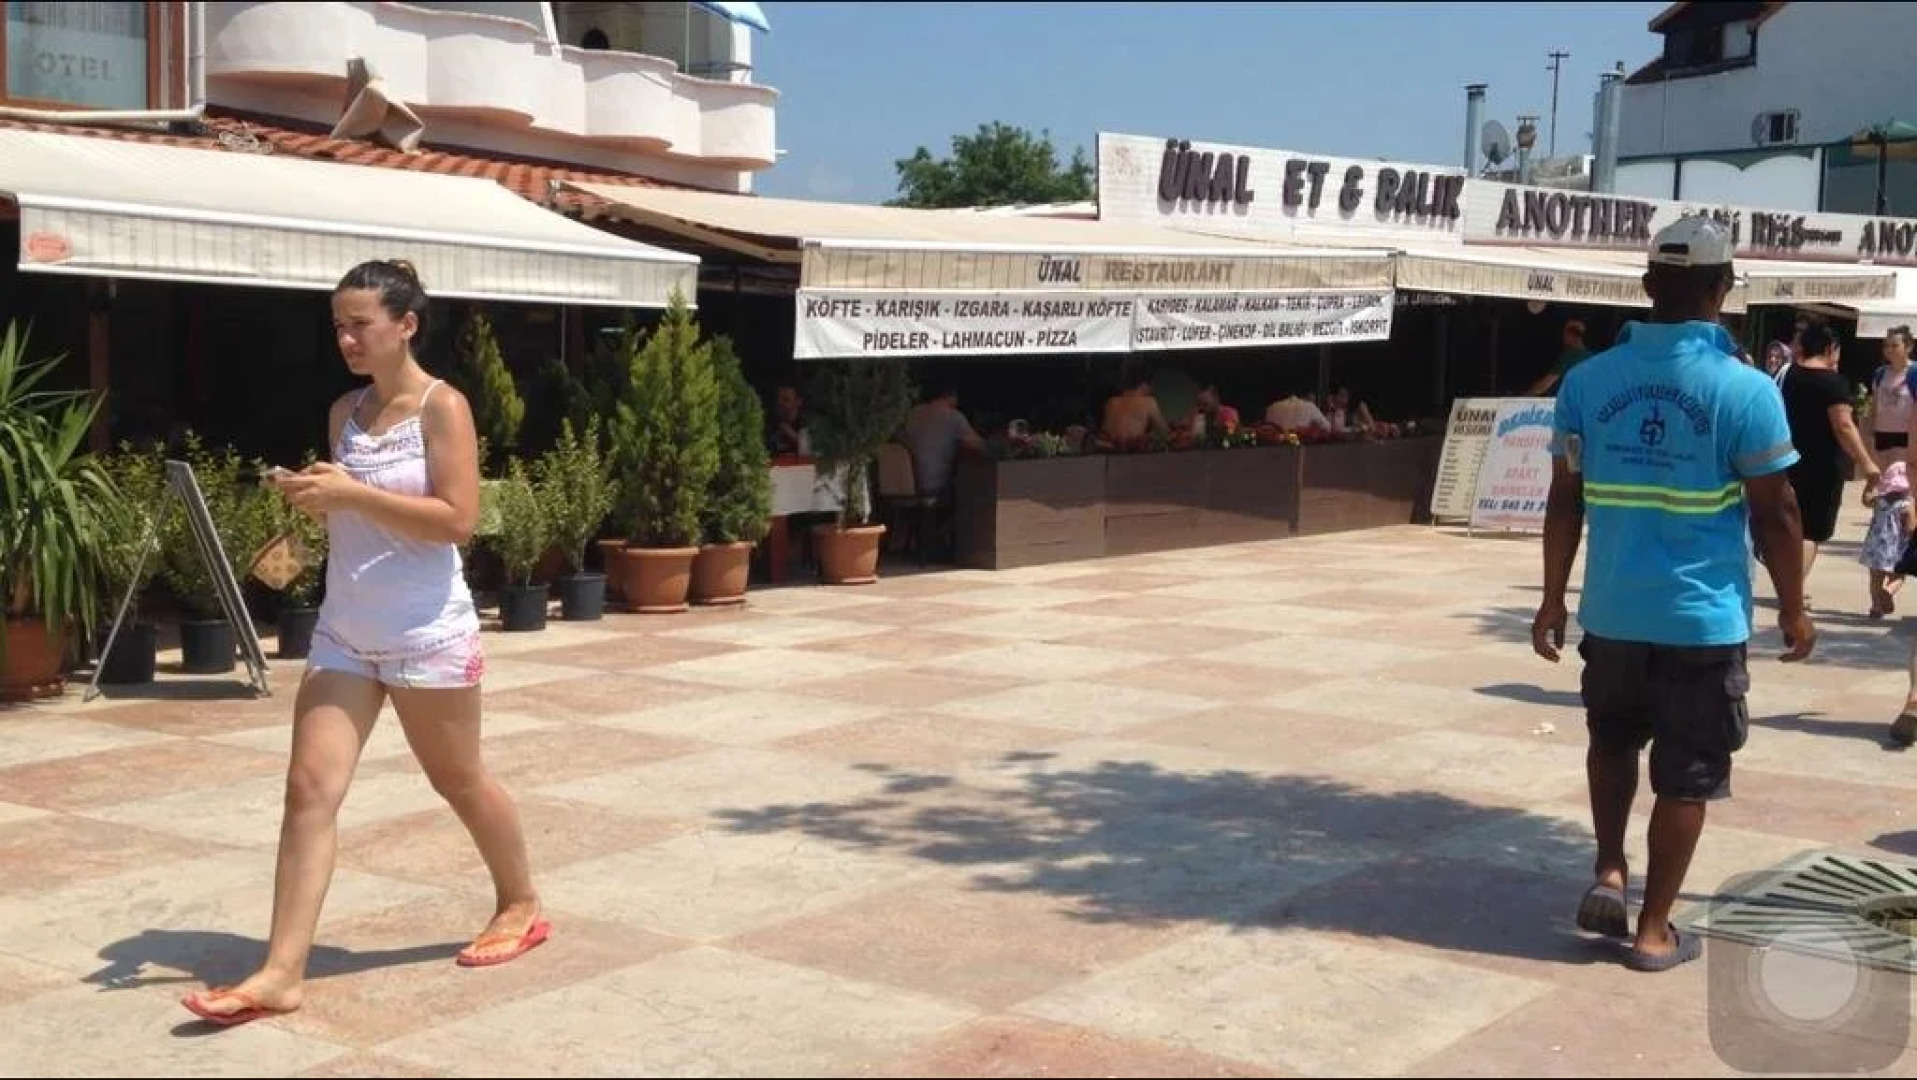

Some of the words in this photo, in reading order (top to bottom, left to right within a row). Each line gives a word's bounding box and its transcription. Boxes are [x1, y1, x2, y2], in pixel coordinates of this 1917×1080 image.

[1158, 138, 1254, 206] ÜNAL
[1282, 159, 1330, 208] ET
[1339, 165, 1364, 212] &
[1375, 168, 1464, 221] BALIK
[1860, 219, 1917, 255] ANO
[1038, 255, 1081, 283] ÜNAL
[1103, 261, 1235, 283] RESTAURANT
[806, 296, 862, 318] KÖFTE
[876, 299, 940, 322] KARIŞIK
[1021, 299, 1082, 321] KAŞARLI
[1086, 297, 1132, 318] KÖFTE
[863, 328, 929, 350] PİDELER
[942, 330, 1025, 349] LAHMACUN
[1036, 326, 1077, 348] PİZZA
